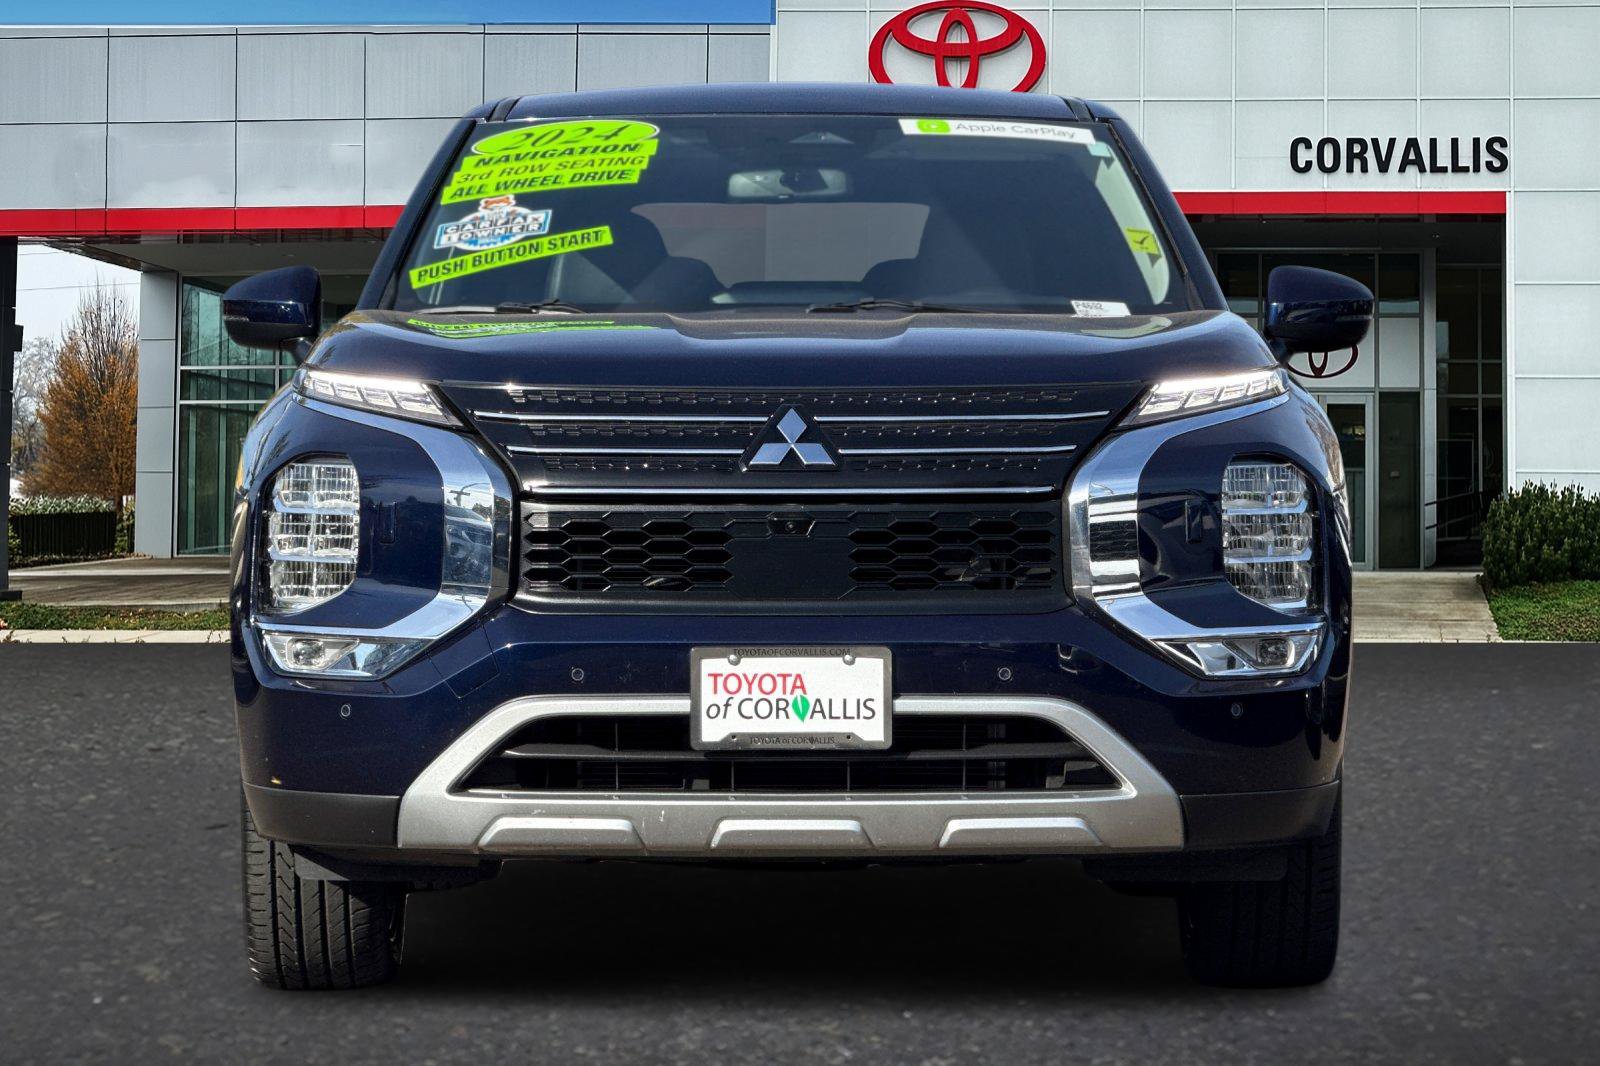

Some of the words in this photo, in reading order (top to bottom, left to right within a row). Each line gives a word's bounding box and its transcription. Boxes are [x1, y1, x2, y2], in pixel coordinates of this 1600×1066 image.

[499, 124, 633, 151] 2024
[955, 123, 1005, 132] Apple
[1011, 126, 1076, 139] CarPlay
[474, 143, 641, 168] NAVIGATION
[1290, 137, 1509, 174] CORVALLIS
[457, 170, 493, 184] 3rd
[499, 164, 549, 177] ROW
[555, 155, 645, 171] SEATING
[451, 184, 489, 199] ALL
[495, 175, 565, 191] WHEEL
[570, 168, 632, 182] DRIVE
[417, 256, 465, 282] PUSH
[472, 243, 540, 268] BUTTON
[547, 230, 602, 251] START
[708, 673, 807, 695] TOYOTA
[706, 697, 734, 720] of
